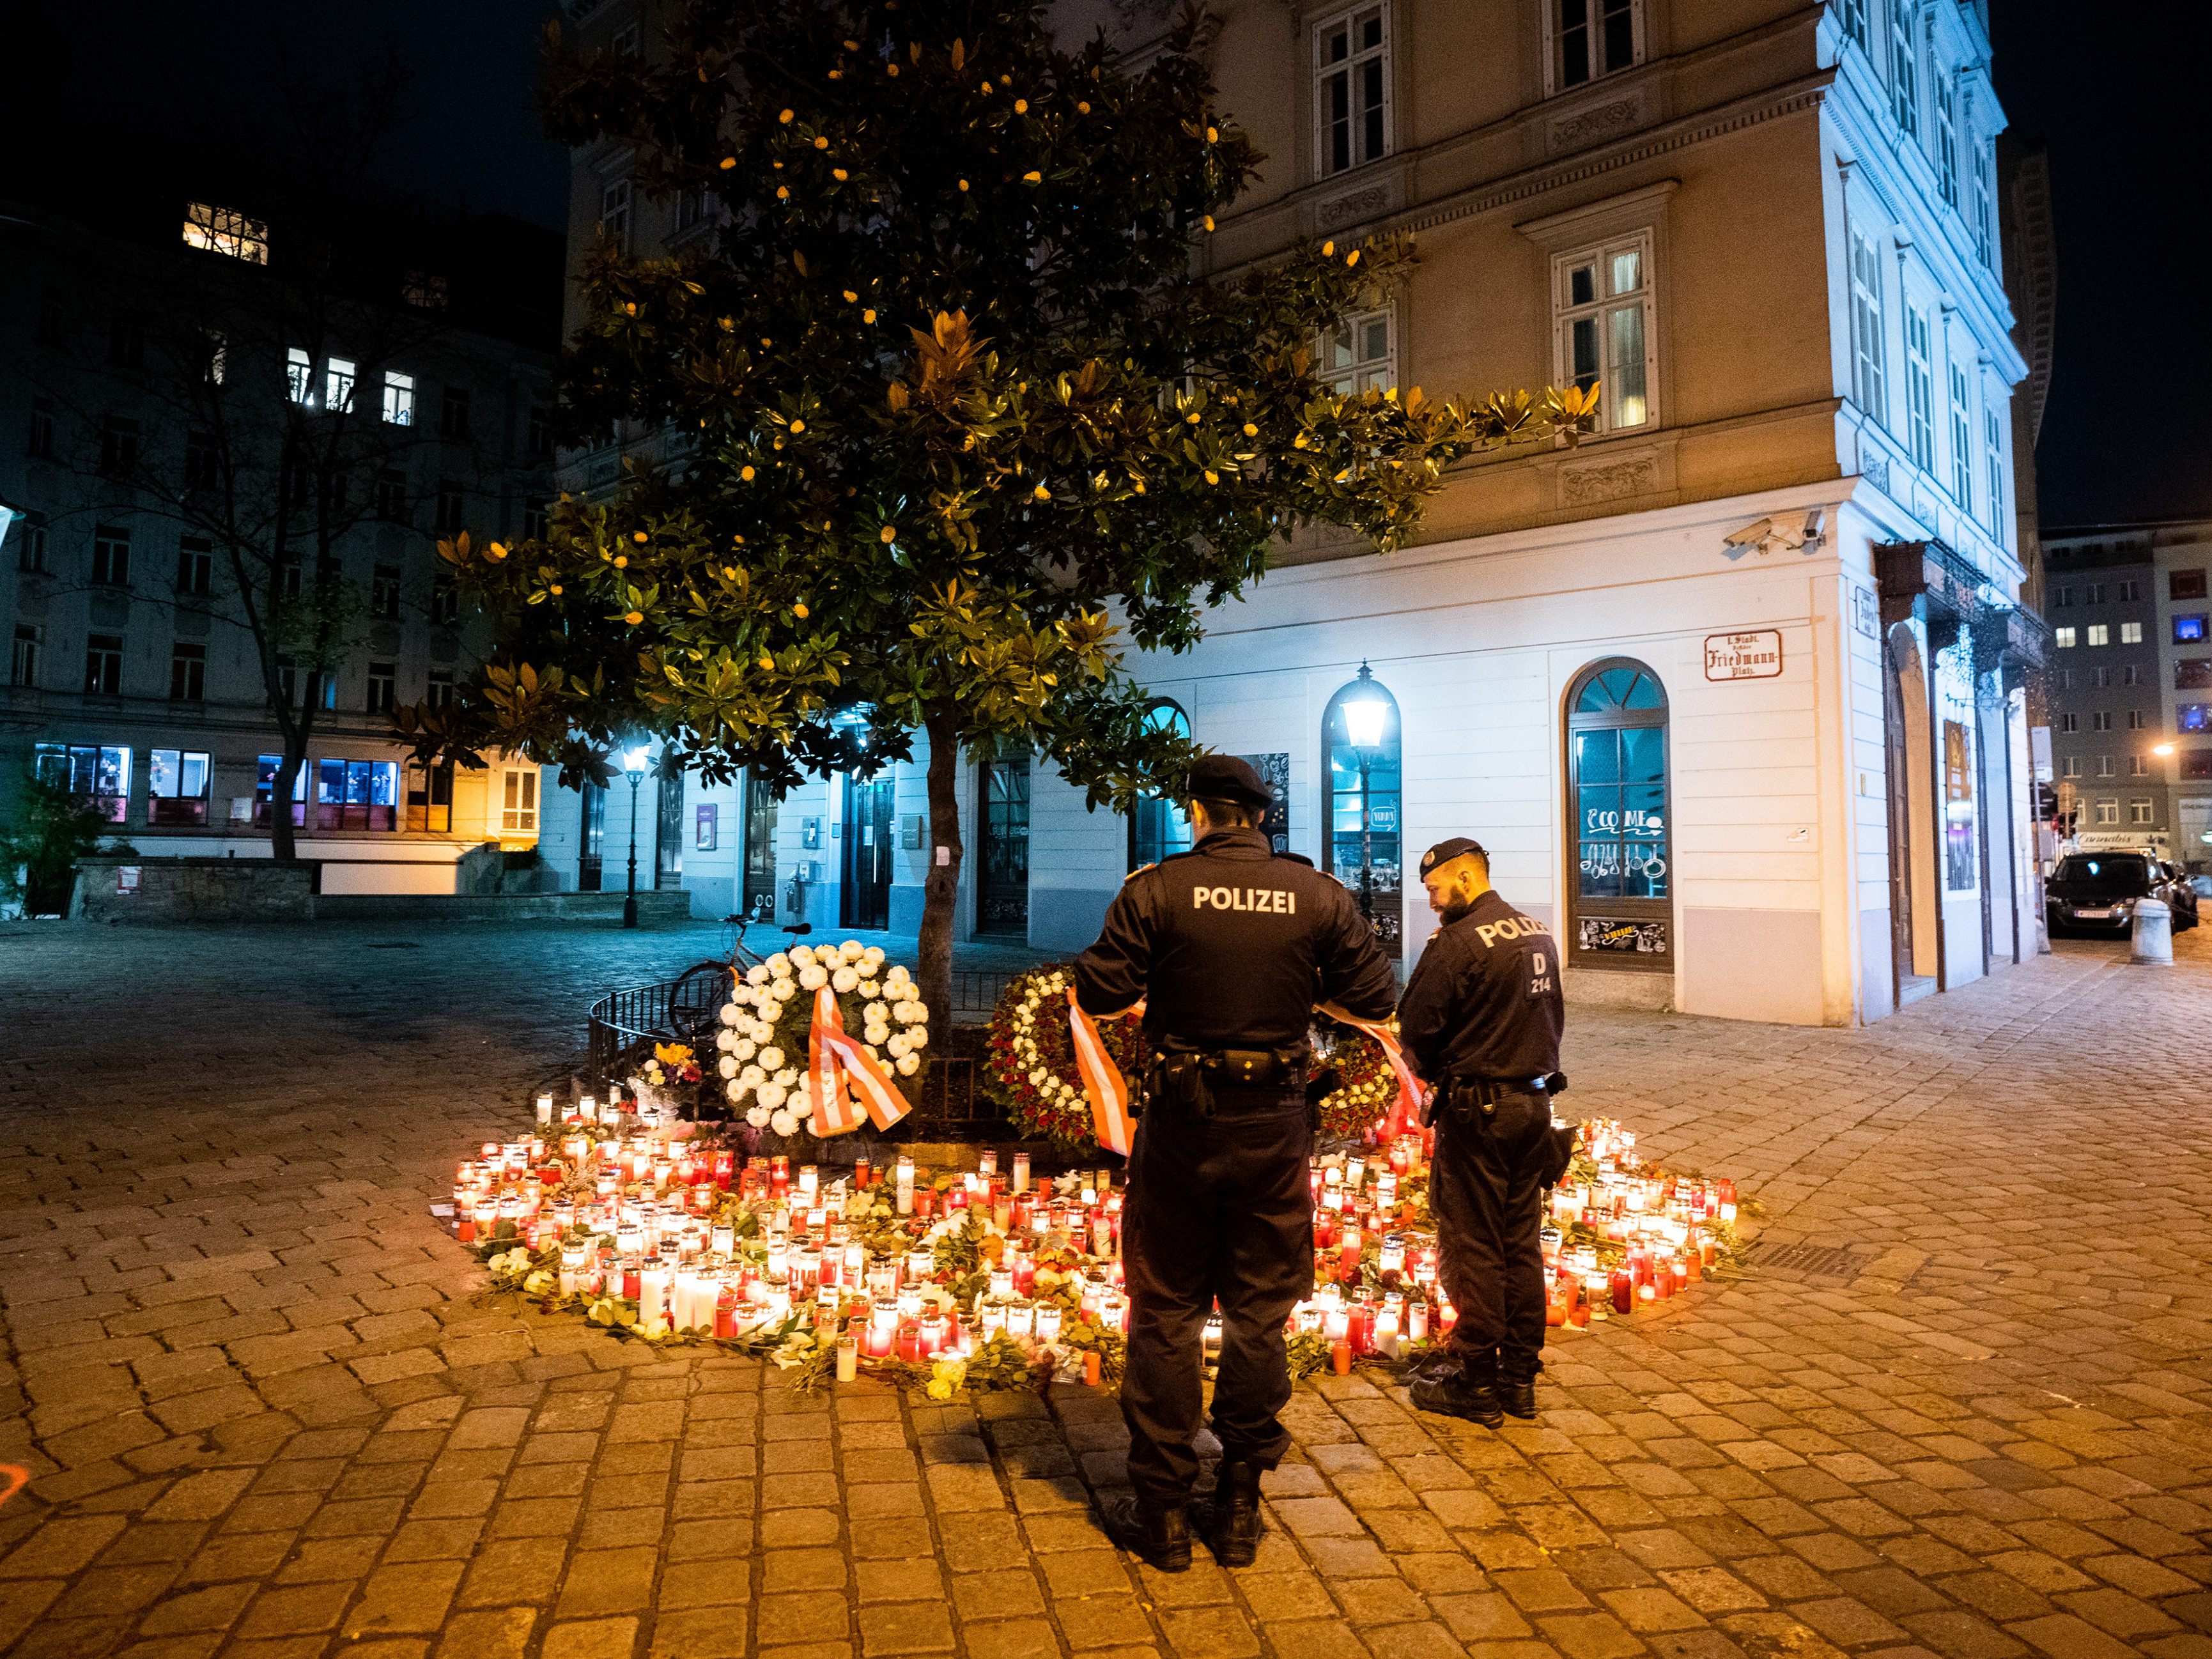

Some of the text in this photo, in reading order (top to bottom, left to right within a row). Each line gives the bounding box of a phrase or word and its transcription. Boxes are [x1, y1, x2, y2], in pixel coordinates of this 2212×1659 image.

[1193, 886, 1295, 914] POLIZEI
[1474, 916, 1552, 948] POLIZE
[1533, 952, 1547, 975] D
[1531, 976, 1551, 994] 214
